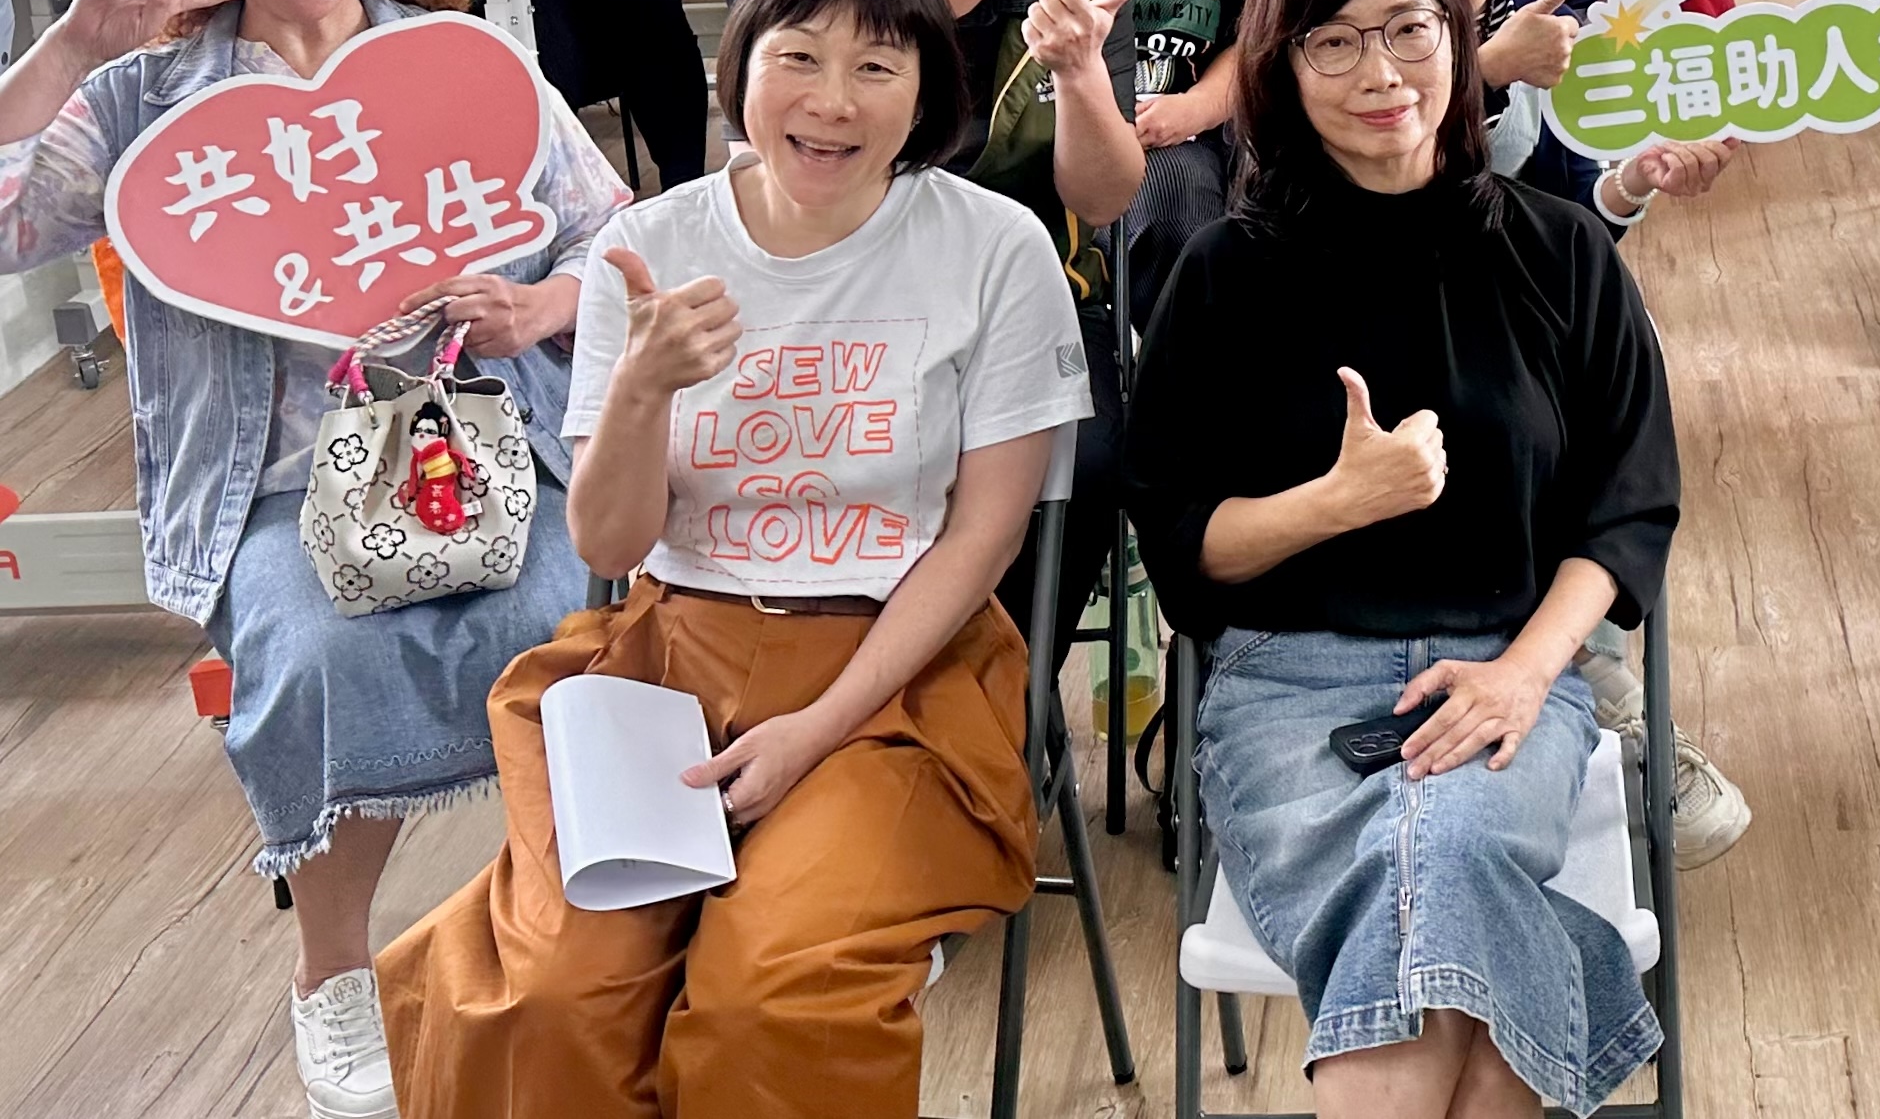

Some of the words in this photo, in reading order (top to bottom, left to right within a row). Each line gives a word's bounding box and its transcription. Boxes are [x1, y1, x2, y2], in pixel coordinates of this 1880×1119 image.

[1173, 2, 1212, 27] CITY
[162, 98, 383, 242] 共好
[273, 252, 333, 317] &
[331, 159, 534, 293] 共生
[732, 341, 888, 400] SEW
[691, 400, 897, 469] LOVE
[708, 499, 909, 566] LOVE
